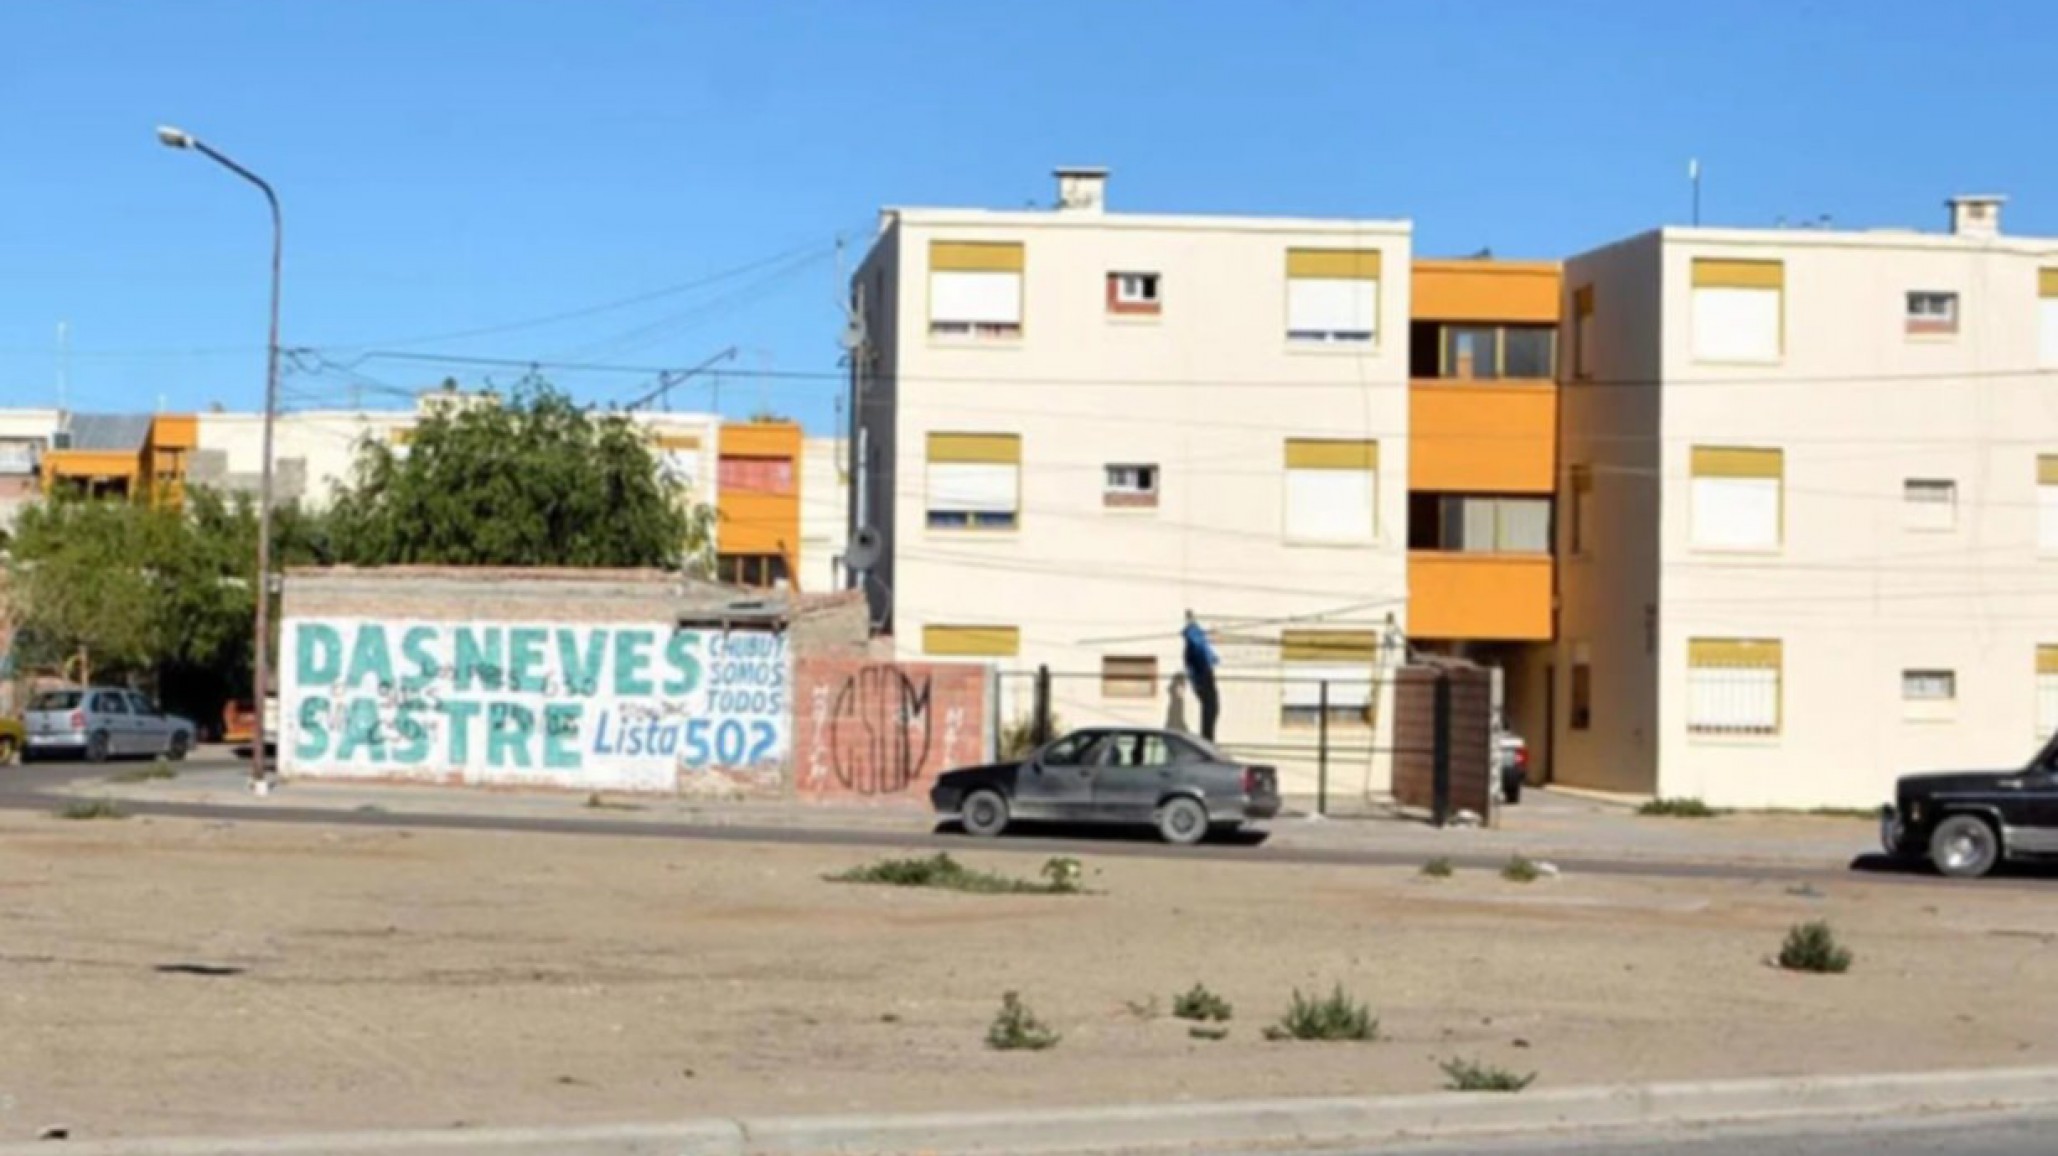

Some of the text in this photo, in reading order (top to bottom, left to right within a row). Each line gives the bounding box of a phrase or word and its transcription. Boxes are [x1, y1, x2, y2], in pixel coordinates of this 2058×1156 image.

[296, 622, 440, 692] DAS
[453, 627, 702, 696] NEVES
[709, 661, 785, 688] SOMOS
[706, 690, 783, 715] TODOS
[294, 696, 584, 769] SASTRE
[593, 710, 679, 756] Lista
[684, 718, 778, 768] 502
